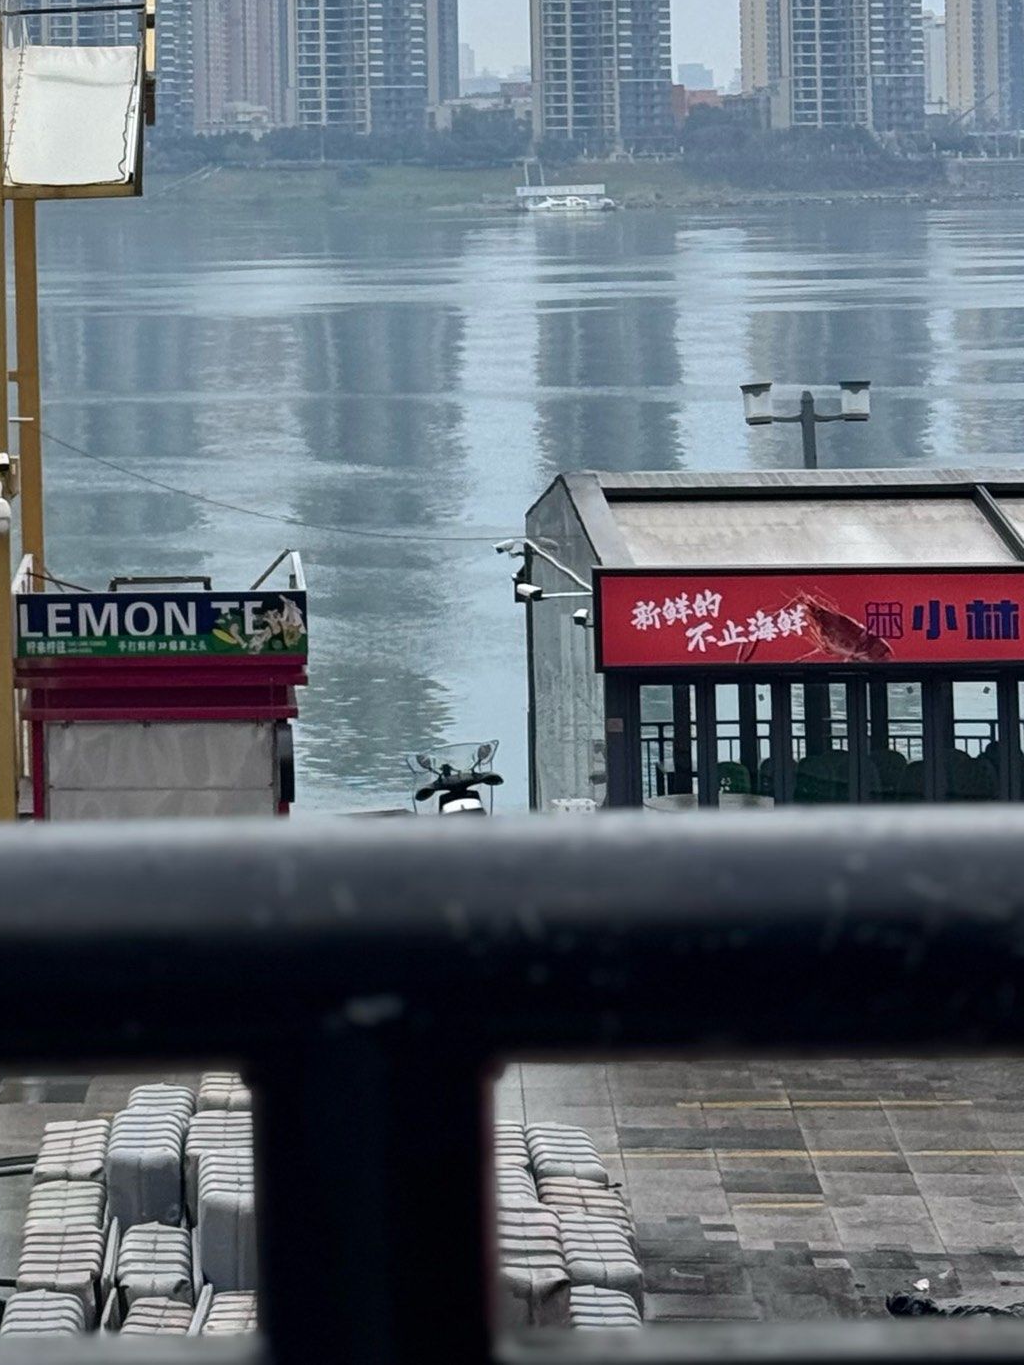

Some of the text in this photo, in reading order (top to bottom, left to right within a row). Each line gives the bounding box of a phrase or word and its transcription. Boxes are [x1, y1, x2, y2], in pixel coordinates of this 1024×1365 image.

[19, 601, 197, 638] LEMON
[631, 589, 722, 631] 新鲜的
[685, 604, 808, 653] 不止海鲜
